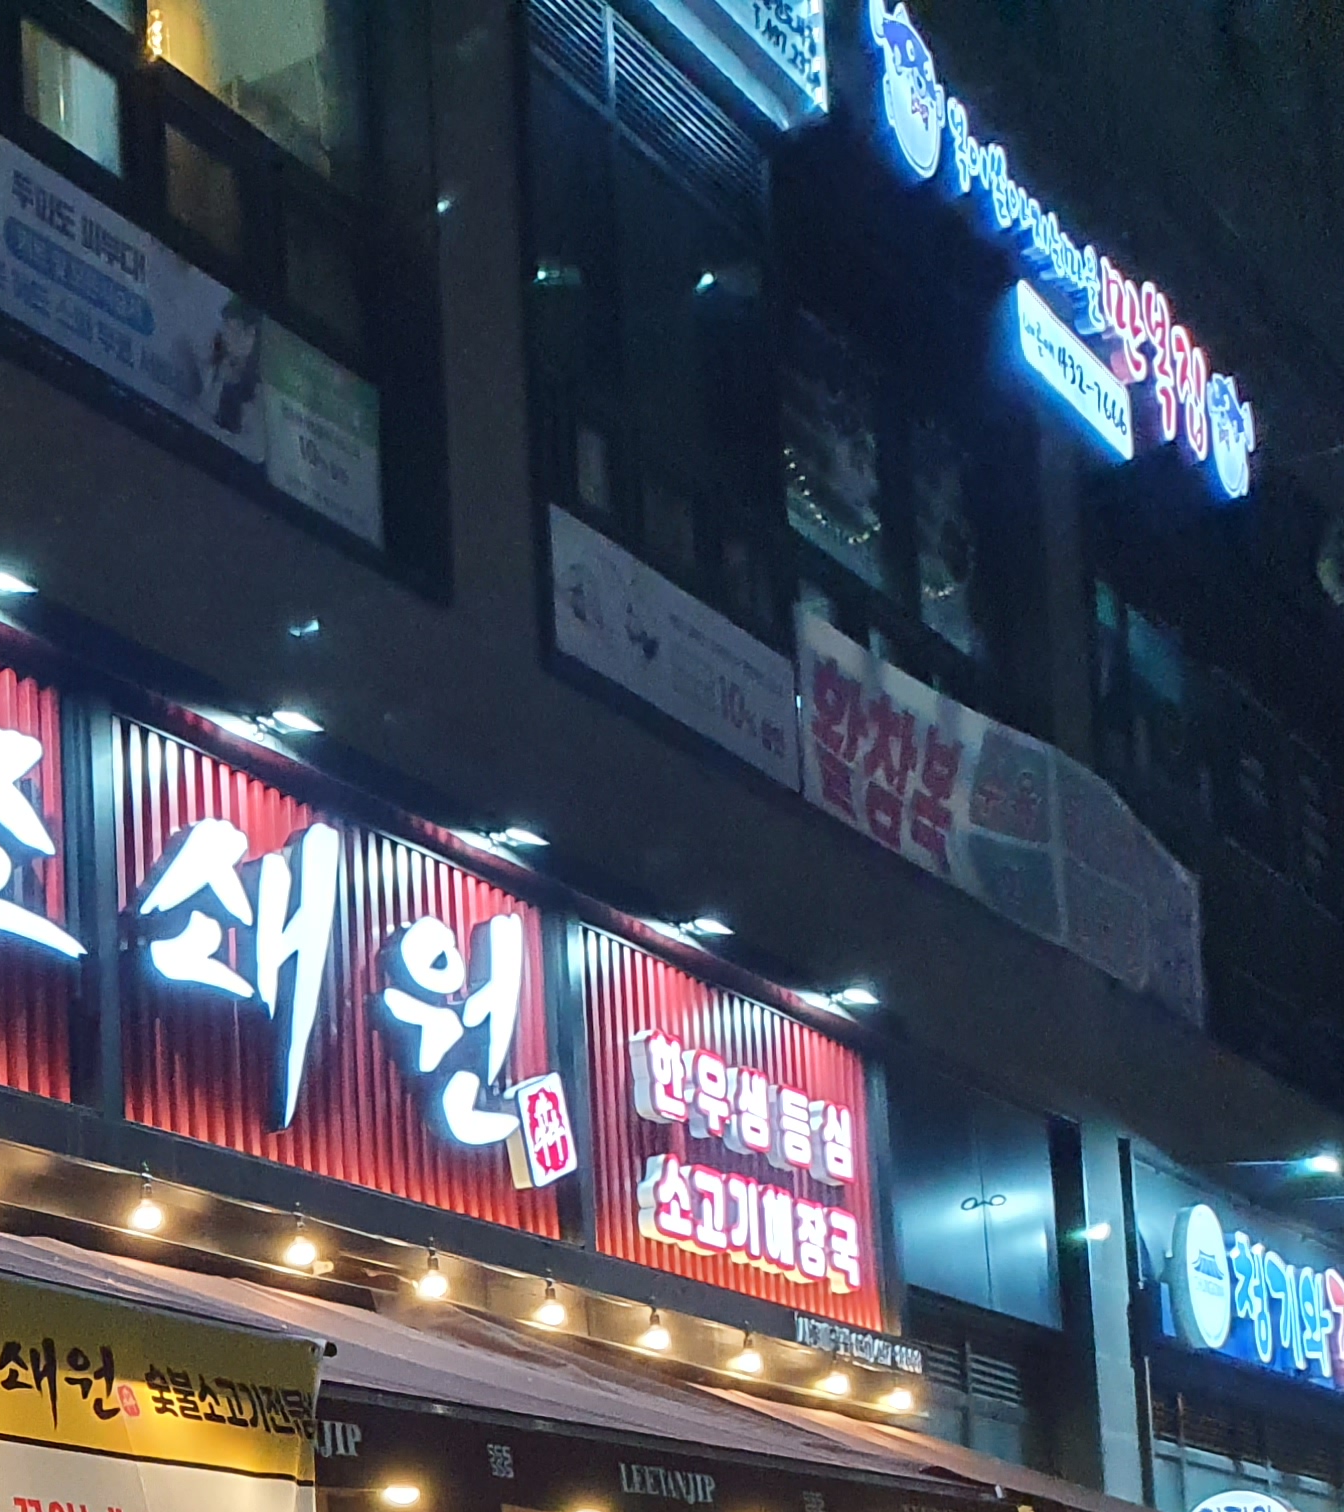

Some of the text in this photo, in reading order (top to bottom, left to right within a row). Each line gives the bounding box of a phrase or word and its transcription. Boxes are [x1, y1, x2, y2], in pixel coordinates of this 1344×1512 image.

[648, 1034, 855, 1187] 한우생등심
[655, 1155, 861, 1291] 소고기해장국
[145, 1363, 313, 1441] 숯불소고기전문
[617, 1460, 717, 1505] LEETANJIP
